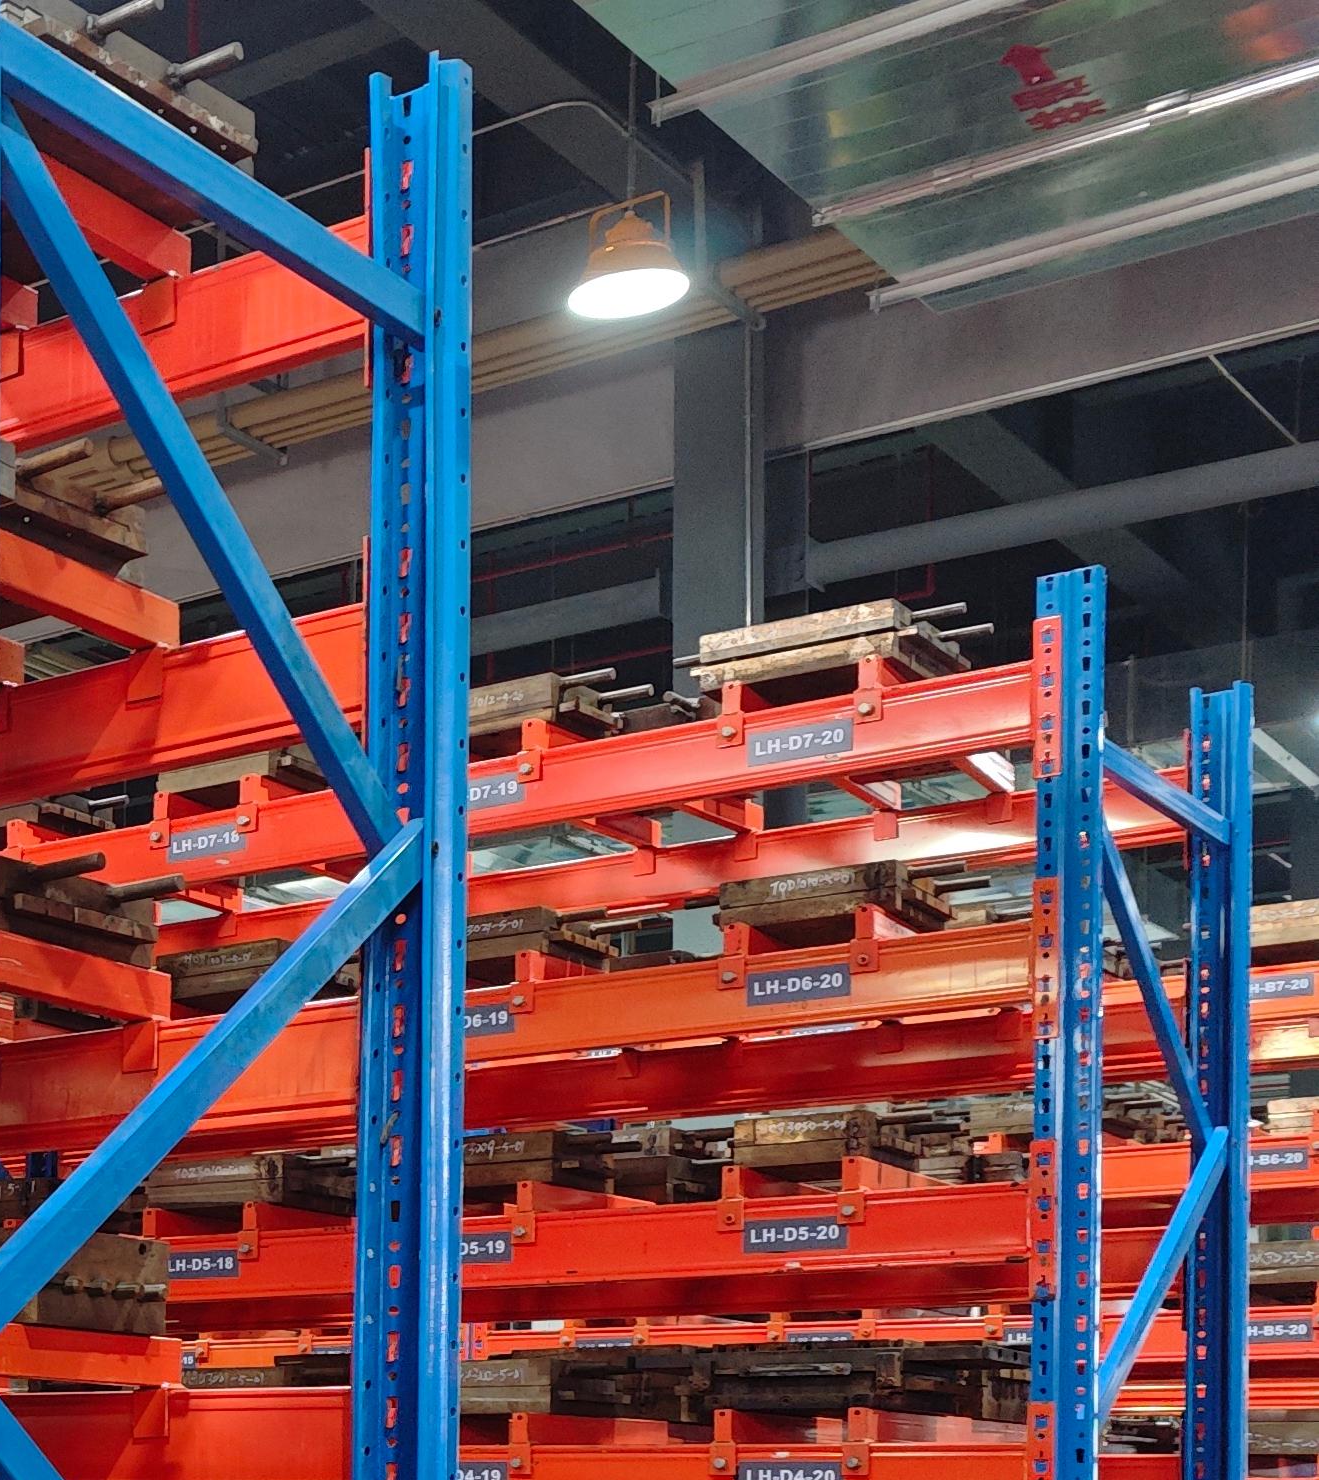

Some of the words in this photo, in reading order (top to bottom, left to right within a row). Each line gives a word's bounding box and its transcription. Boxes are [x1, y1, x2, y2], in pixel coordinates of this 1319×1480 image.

[755, 728, 844, 756] LH-D7-20
[172, 832, 240, 855] LH-D7-18
[753, 972, 843, 997] LH-D6-20
[750, 1224, 838, 1245] LH-D5-20
[168, 1256, 235, 1273] LH-D5-18
